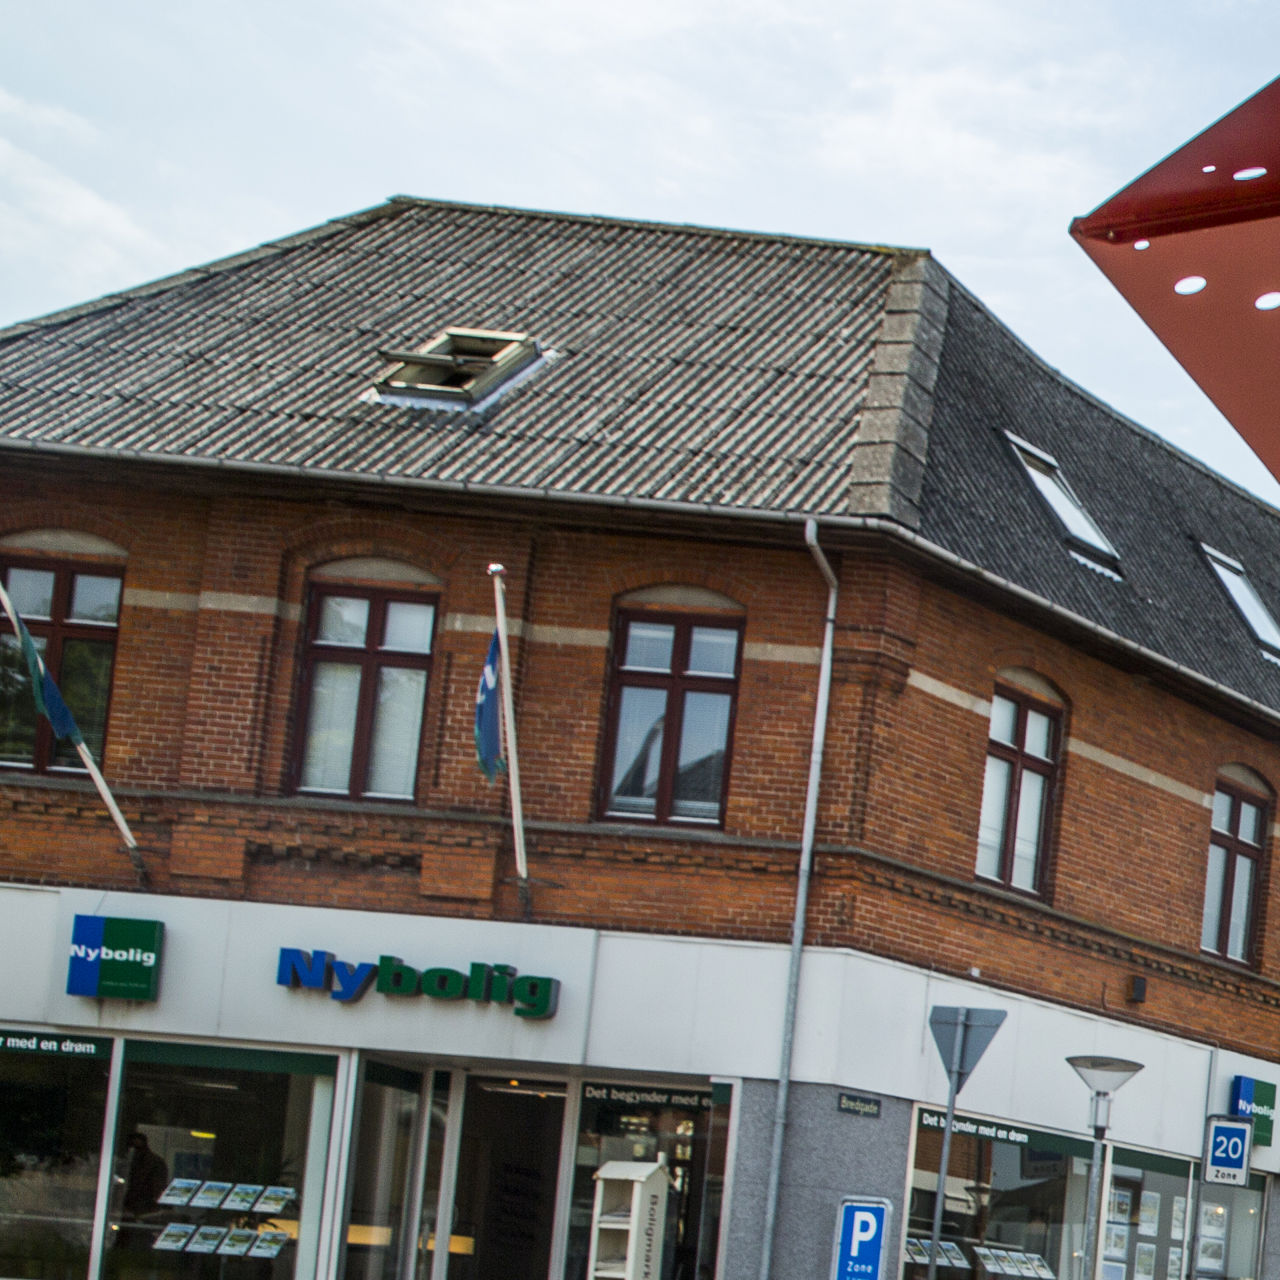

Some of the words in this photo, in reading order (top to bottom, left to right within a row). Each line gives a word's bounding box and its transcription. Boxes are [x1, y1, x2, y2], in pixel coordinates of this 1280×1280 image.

[70, 944, 156, 967] Nybolig
[276, 946, 561, 1020] Nybolig
[6, 1036, 37, 1050] med
[40, 1040, 58, 1052] en
[585, 1086, 608, 1100] Det
[610, 1088, 669, 1105] begynder
[671, 1093, 699, 1106] med
[1238, 1099, 1276, 1121] Nybolig
[922, 1112, 938, 1127] Det
[939, 1116, 978, 1134] bgynder
[997, 1129, 1008, 1140] en
[1214, 1135, 1243, 1159] 20
[1214, 1169, 1237, 1180] Zone
[850, 1210, 878, 1257] P
[846, 1261, 873, 1274] Zone
